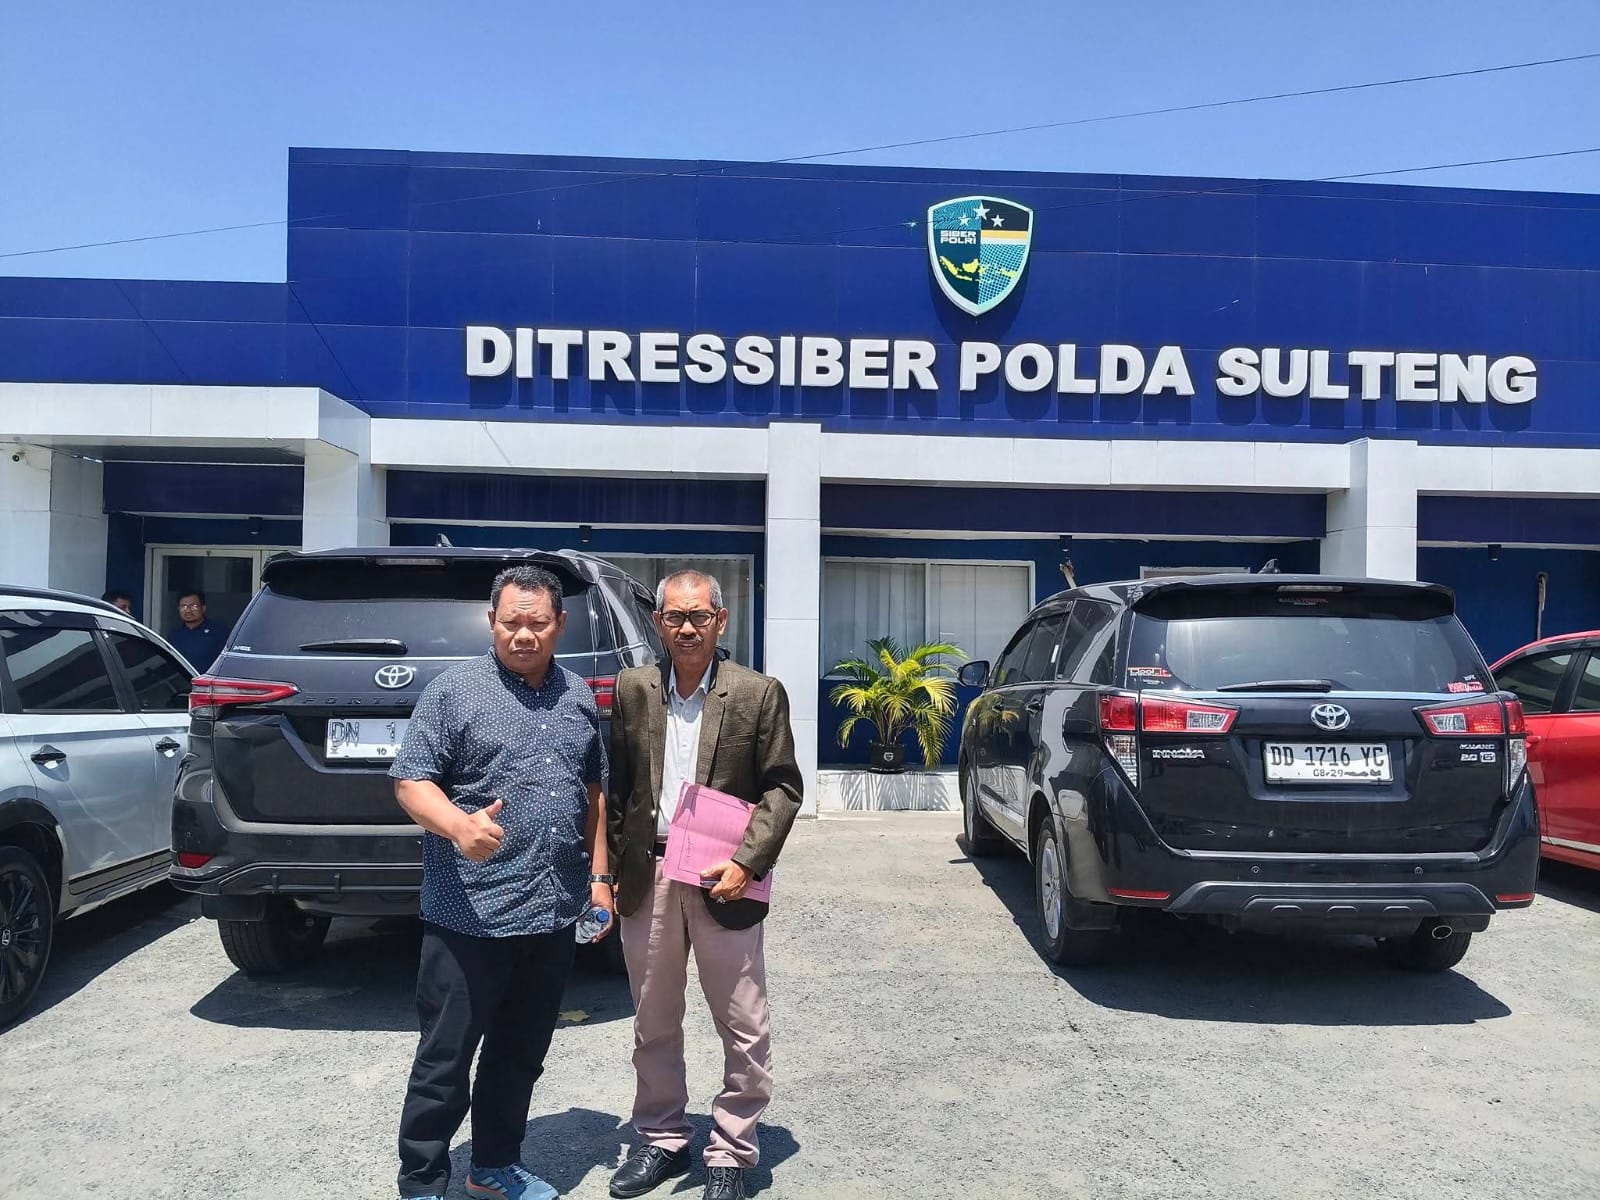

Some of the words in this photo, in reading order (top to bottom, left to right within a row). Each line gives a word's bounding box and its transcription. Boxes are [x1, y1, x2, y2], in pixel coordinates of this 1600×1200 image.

[465, 325, 939, 391] DITRESSIBER
[959, 341, 1195, 397] POLDA
[1216, 347, 1537, 405] SULTENG
[302, 696, 410, 705] FORTU
[331, 721, 360, 747] DN
[1270, 746, 1294, 766] DD
[1304, 746, 1351, 767] 1716
[1361, 746, 1385, 767] YC
